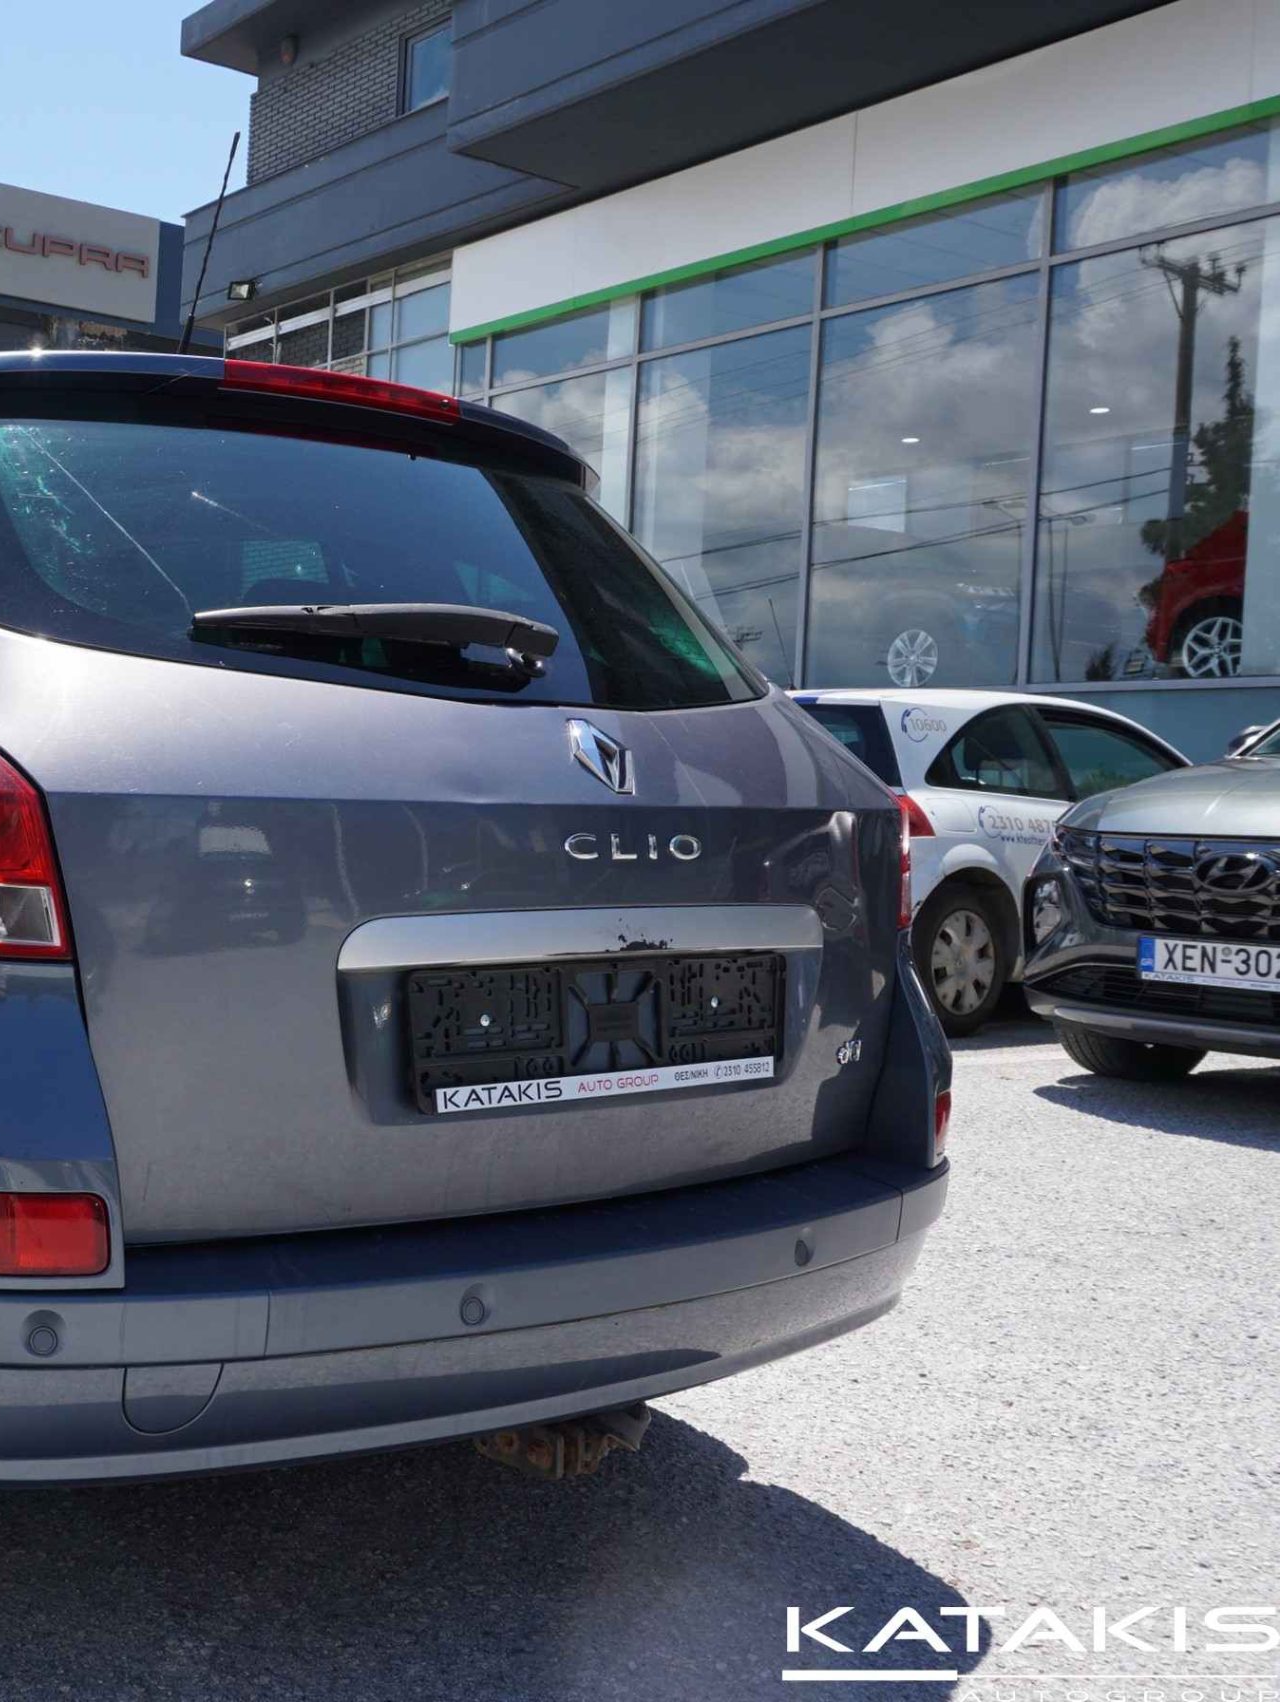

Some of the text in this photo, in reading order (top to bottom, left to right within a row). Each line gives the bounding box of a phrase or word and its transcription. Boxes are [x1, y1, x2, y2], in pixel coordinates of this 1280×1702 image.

[909, 718, 947, 732] 10600
[988, 815, 1024, 831] 2310
[564, 832, 702, 860] CLIO
[1163, 942, 1280, 979] XEN-30
[443, 1080, 562, 1110] KATAKIS
[577, 1079, 612, 1093] AUTO
[616, 1074, 659, 1089] GROUP
